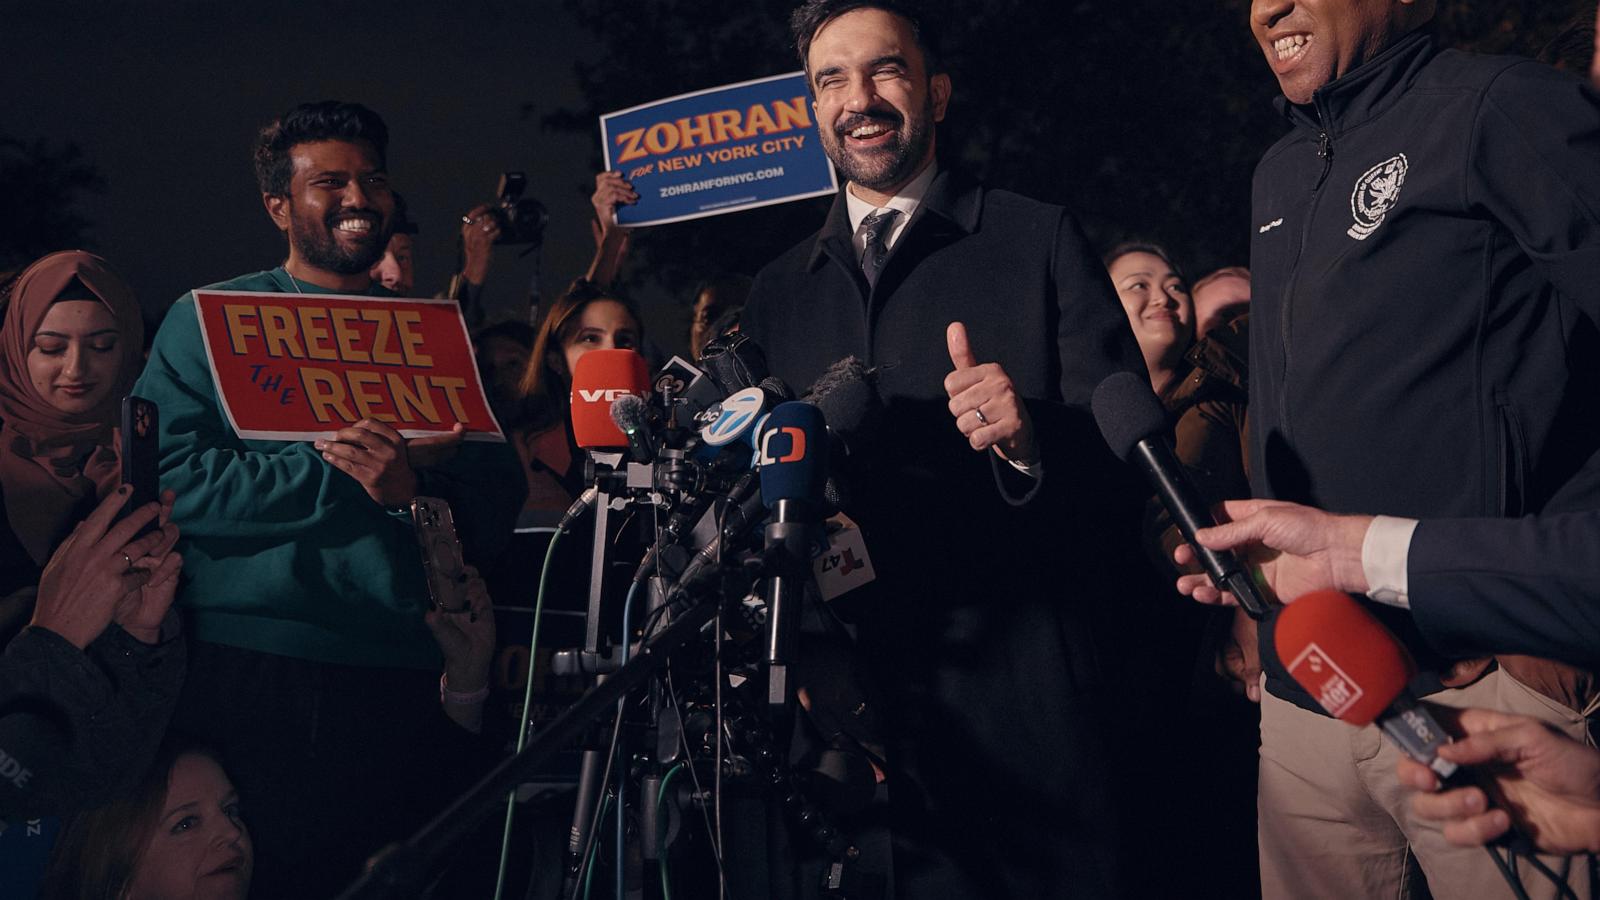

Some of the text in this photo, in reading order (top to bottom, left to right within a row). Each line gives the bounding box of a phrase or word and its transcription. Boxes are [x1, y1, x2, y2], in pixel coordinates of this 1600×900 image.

[616, 96, 812, 163] ZOHRAN
[629, 135, 806, 180] FOR NEW YORK CITY
[660, 166, 785, 198] ZOHRANFORNYC.COM
[222, 304, 434, 367] FREEZE
[249, 364, 470, 424] THE RENT
[822, 554, 841, 573] 47
